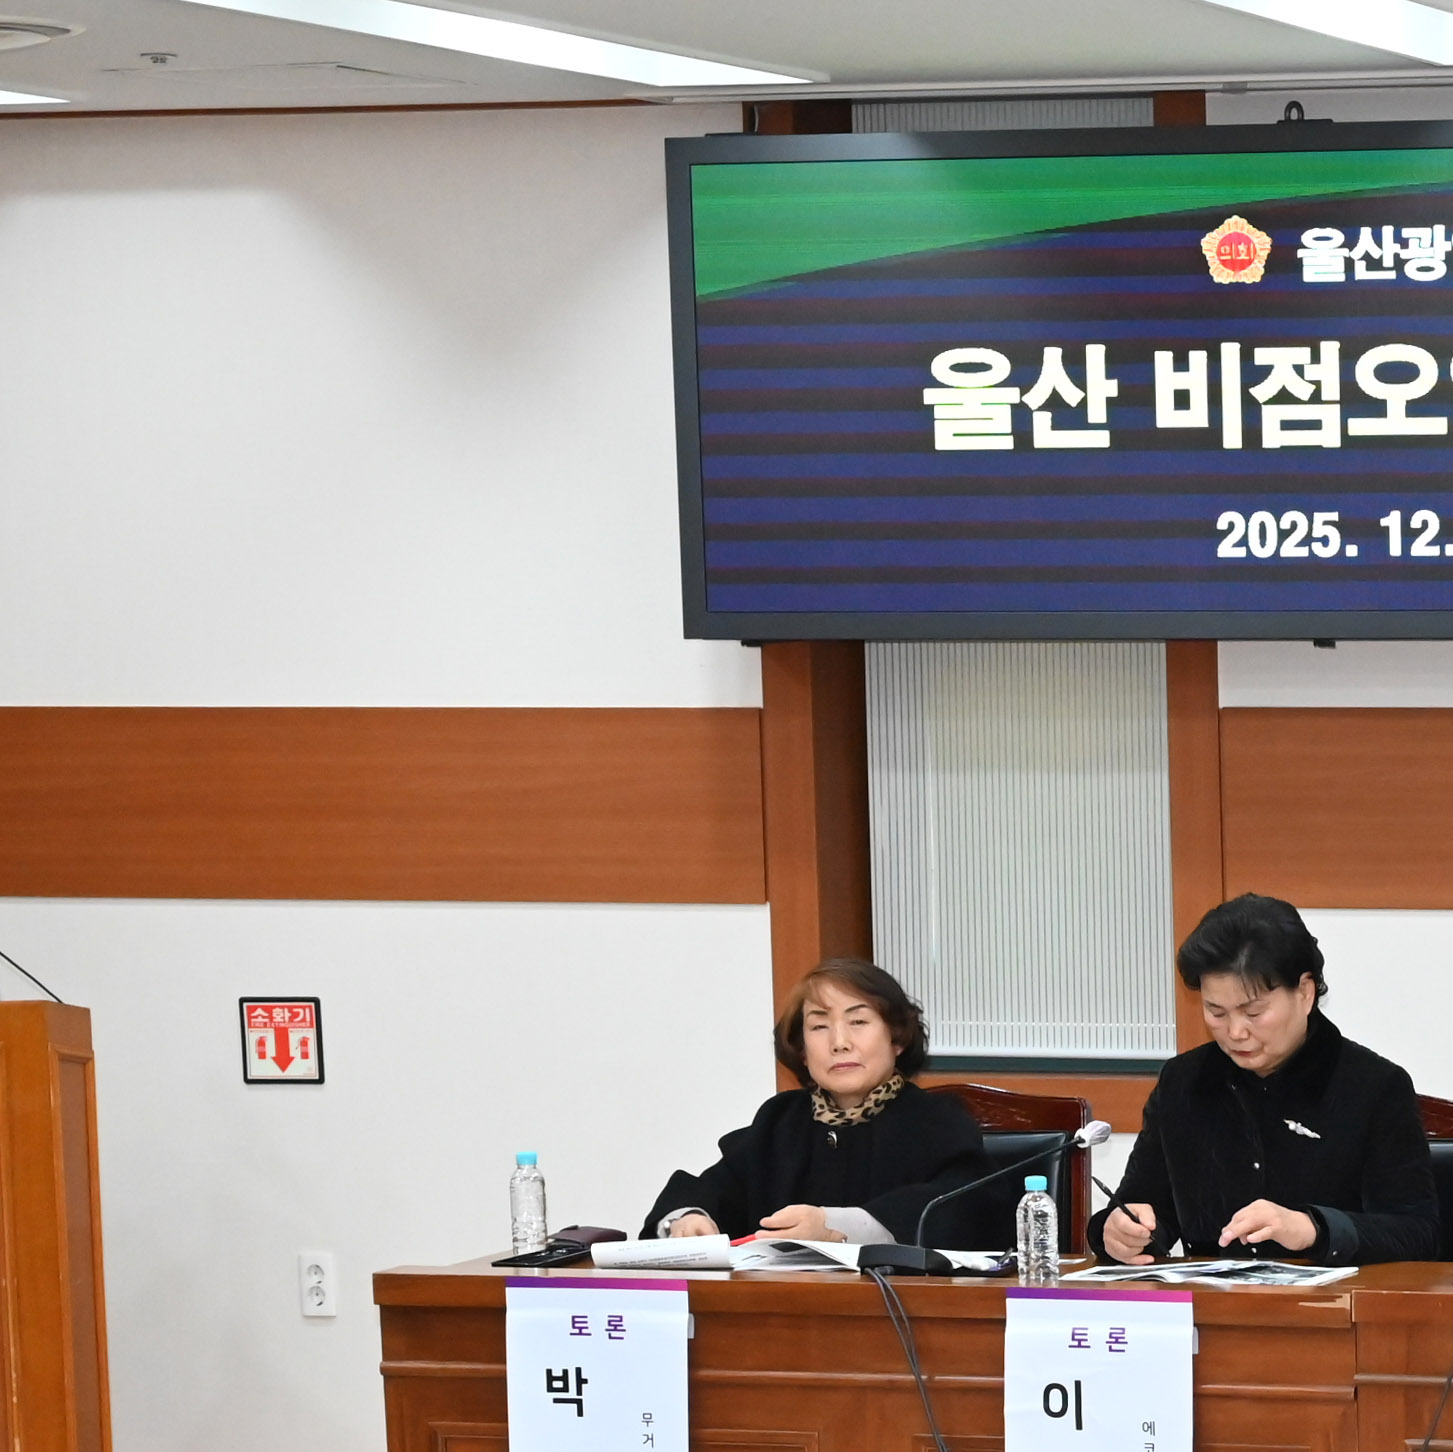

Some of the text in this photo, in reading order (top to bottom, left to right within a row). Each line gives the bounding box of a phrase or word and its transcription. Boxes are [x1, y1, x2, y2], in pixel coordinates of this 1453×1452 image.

[1219, 241, 1254, 260] 의회
[922, 343, 1119, 451] 울산
[1216, 510, 1358, 558] 2025.
[250, 1007, 311, 1022] 소화기
[569, 1314, 627, 1341] 토론
[1067, 1327, 1129, 1353] 토론
